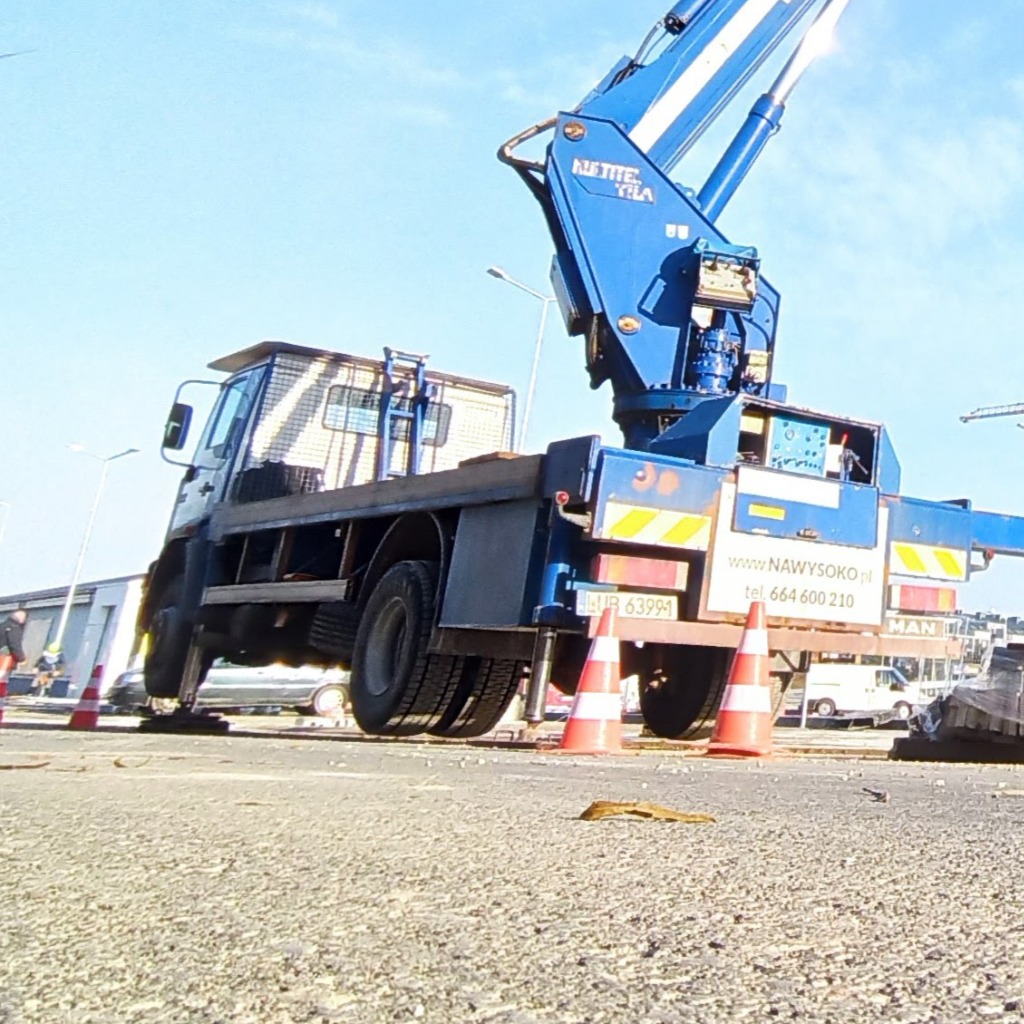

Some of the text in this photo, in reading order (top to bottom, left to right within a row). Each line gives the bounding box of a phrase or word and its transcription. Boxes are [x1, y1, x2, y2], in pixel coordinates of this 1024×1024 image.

[769, 586, 797, 603] 664
[799, 589, 826, 606] 600
[828, 591, 855, 608] 210
[888, 619, 936, 635] MAN
